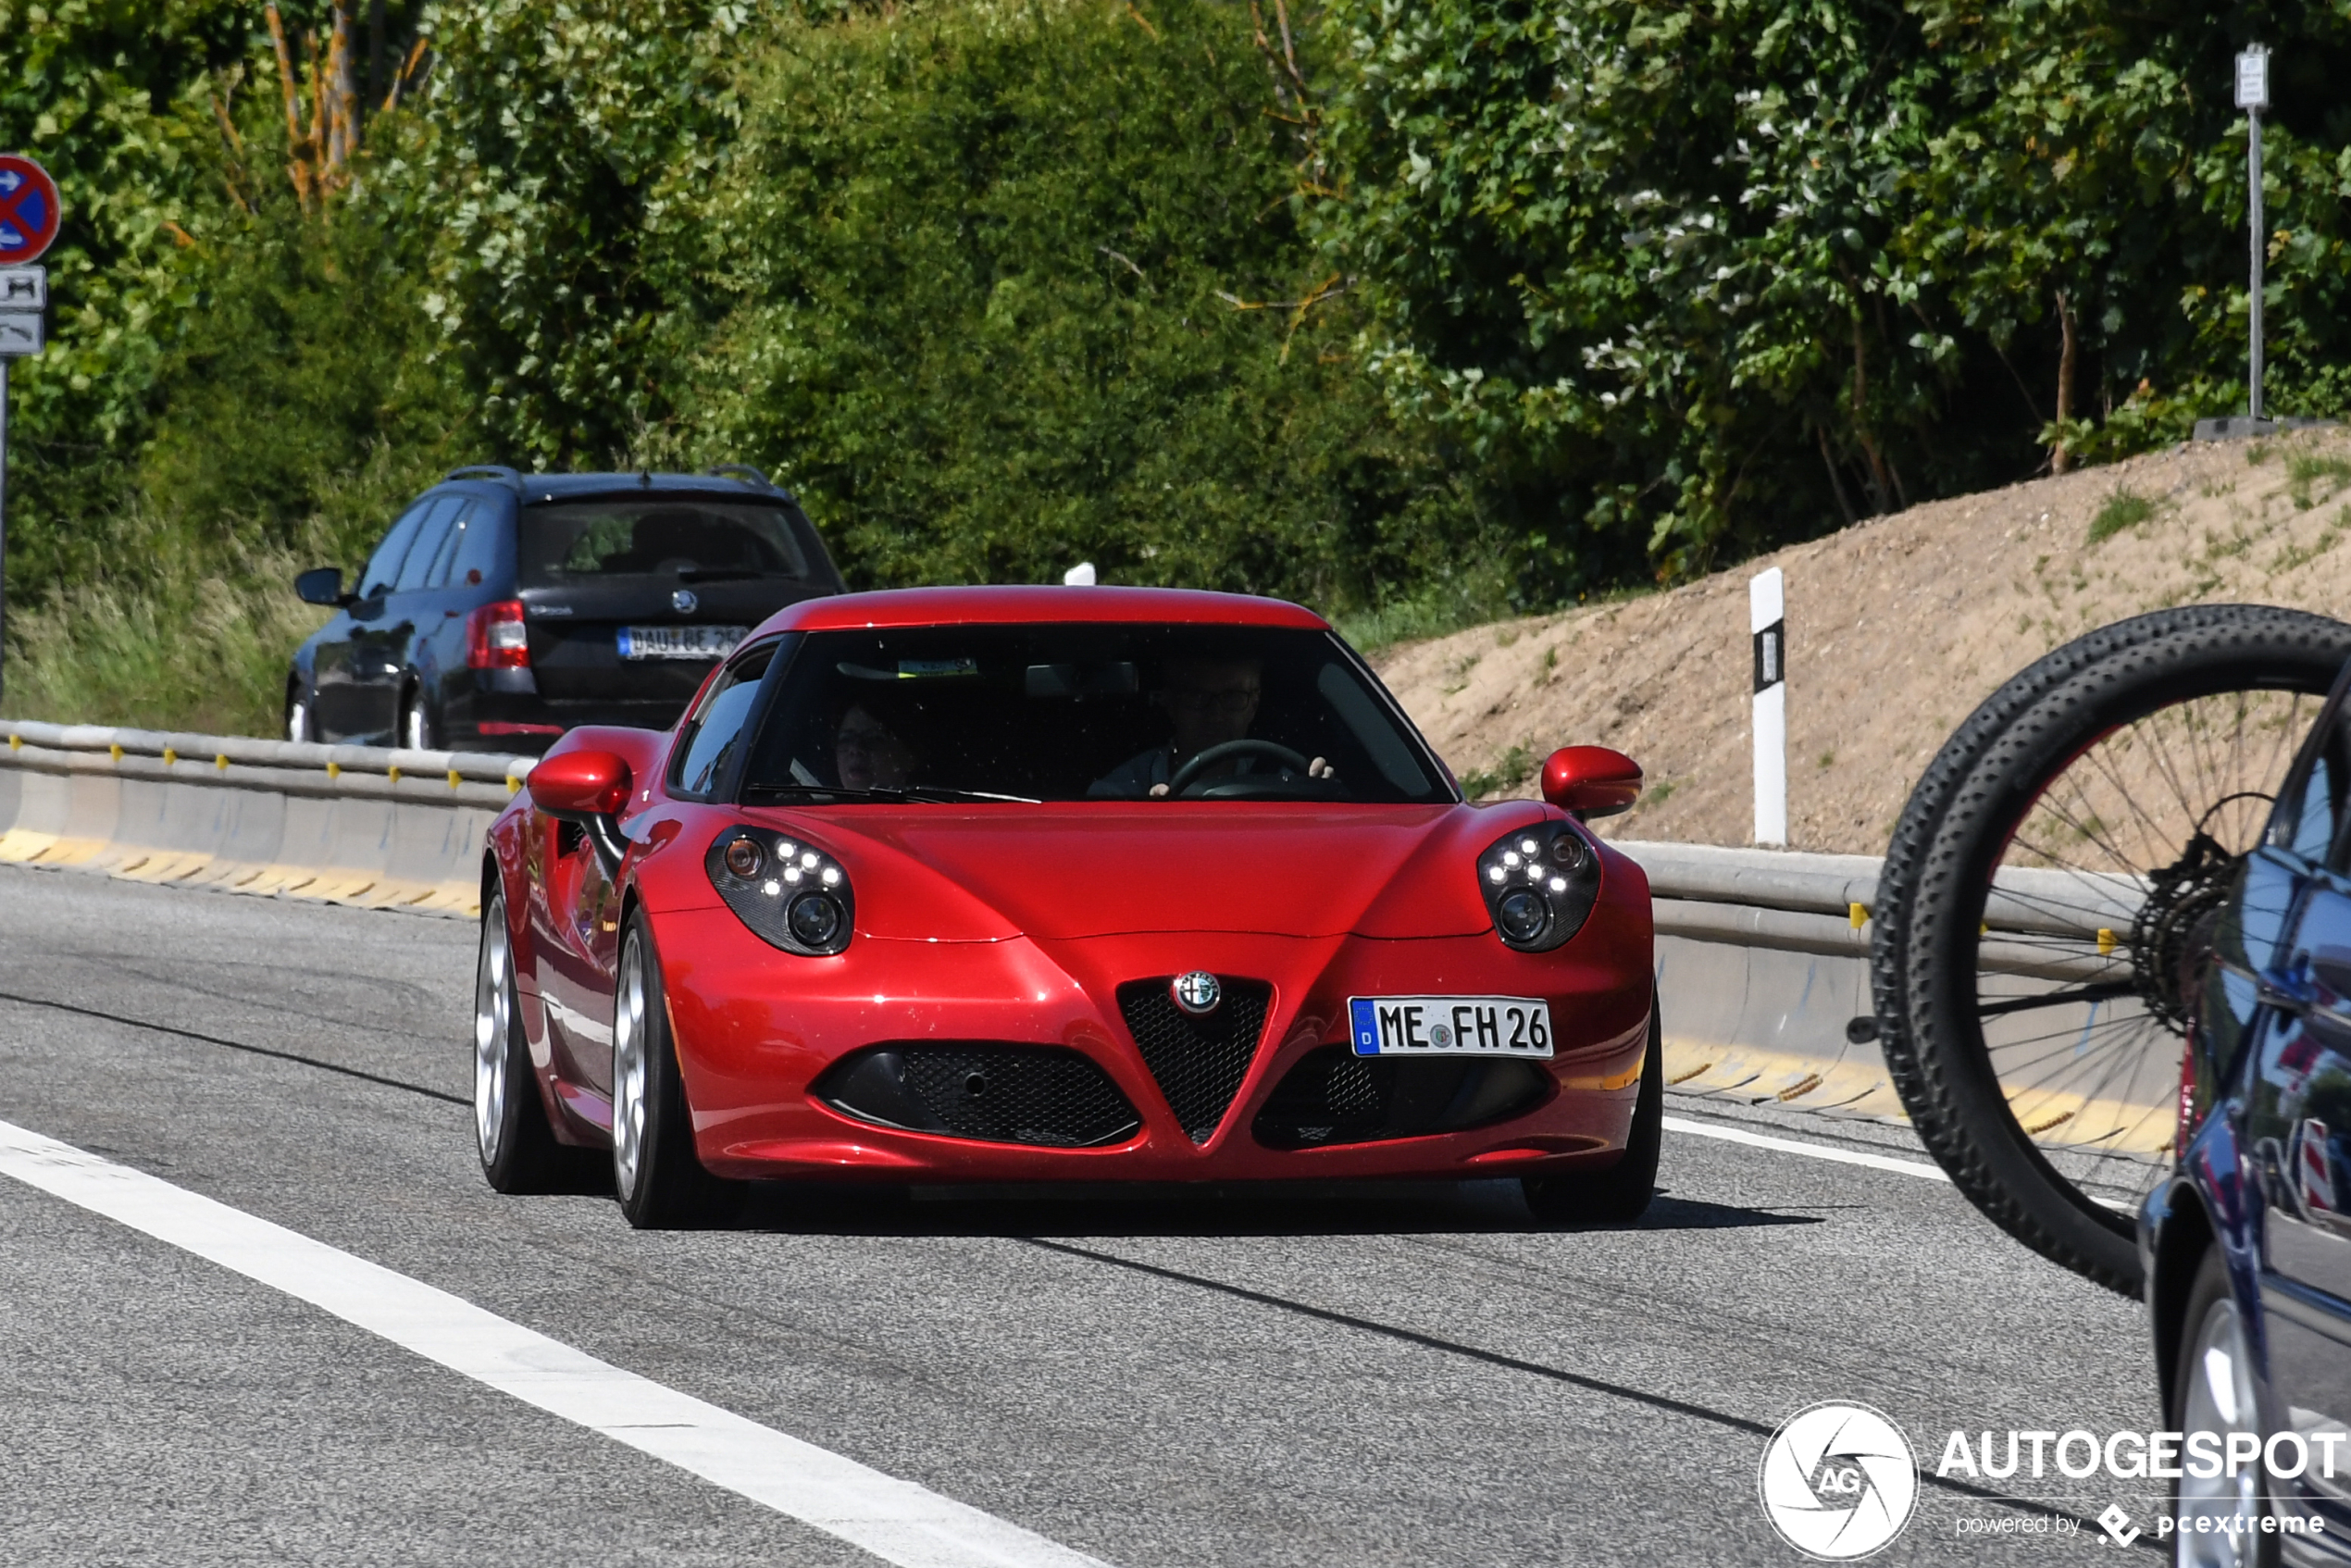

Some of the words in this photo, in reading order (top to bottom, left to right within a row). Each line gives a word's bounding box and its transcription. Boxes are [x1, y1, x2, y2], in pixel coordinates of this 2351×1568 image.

[1362, 1032, 1372, 1045] D
[1378, 1005, 1429, 1048] ME
[1451, 1005, 1500, 1048] FH
[1506, 1007, 1548, 1050] 26
